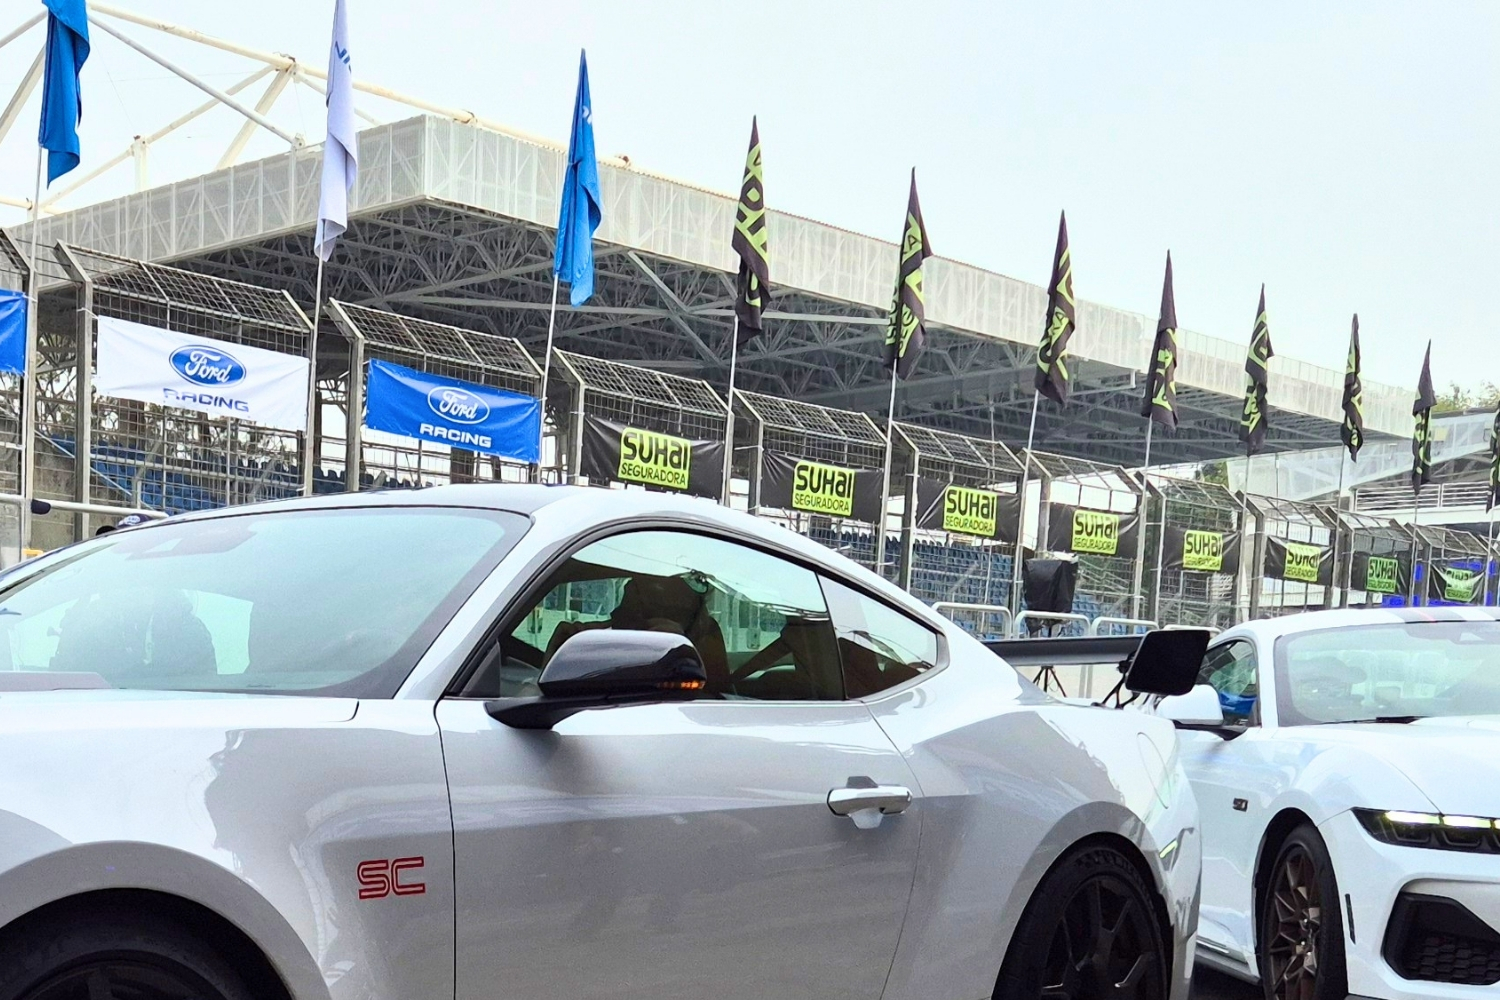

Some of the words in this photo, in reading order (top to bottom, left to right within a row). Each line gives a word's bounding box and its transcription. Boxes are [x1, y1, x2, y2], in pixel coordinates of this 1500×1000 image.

[185, 350, 233, 383] Ford
[163, 388, 249, 412] RACING
[439, 390, 479, 419] Ford
[420, 423, 492, 448] RACING
[621, 462, 686, 486] SEGURADORA
[794, 493, 850, 512] SEGURADORA
[945, 515, 993, 533] SEGURADORA
[357, 856, 426, 899] SC
